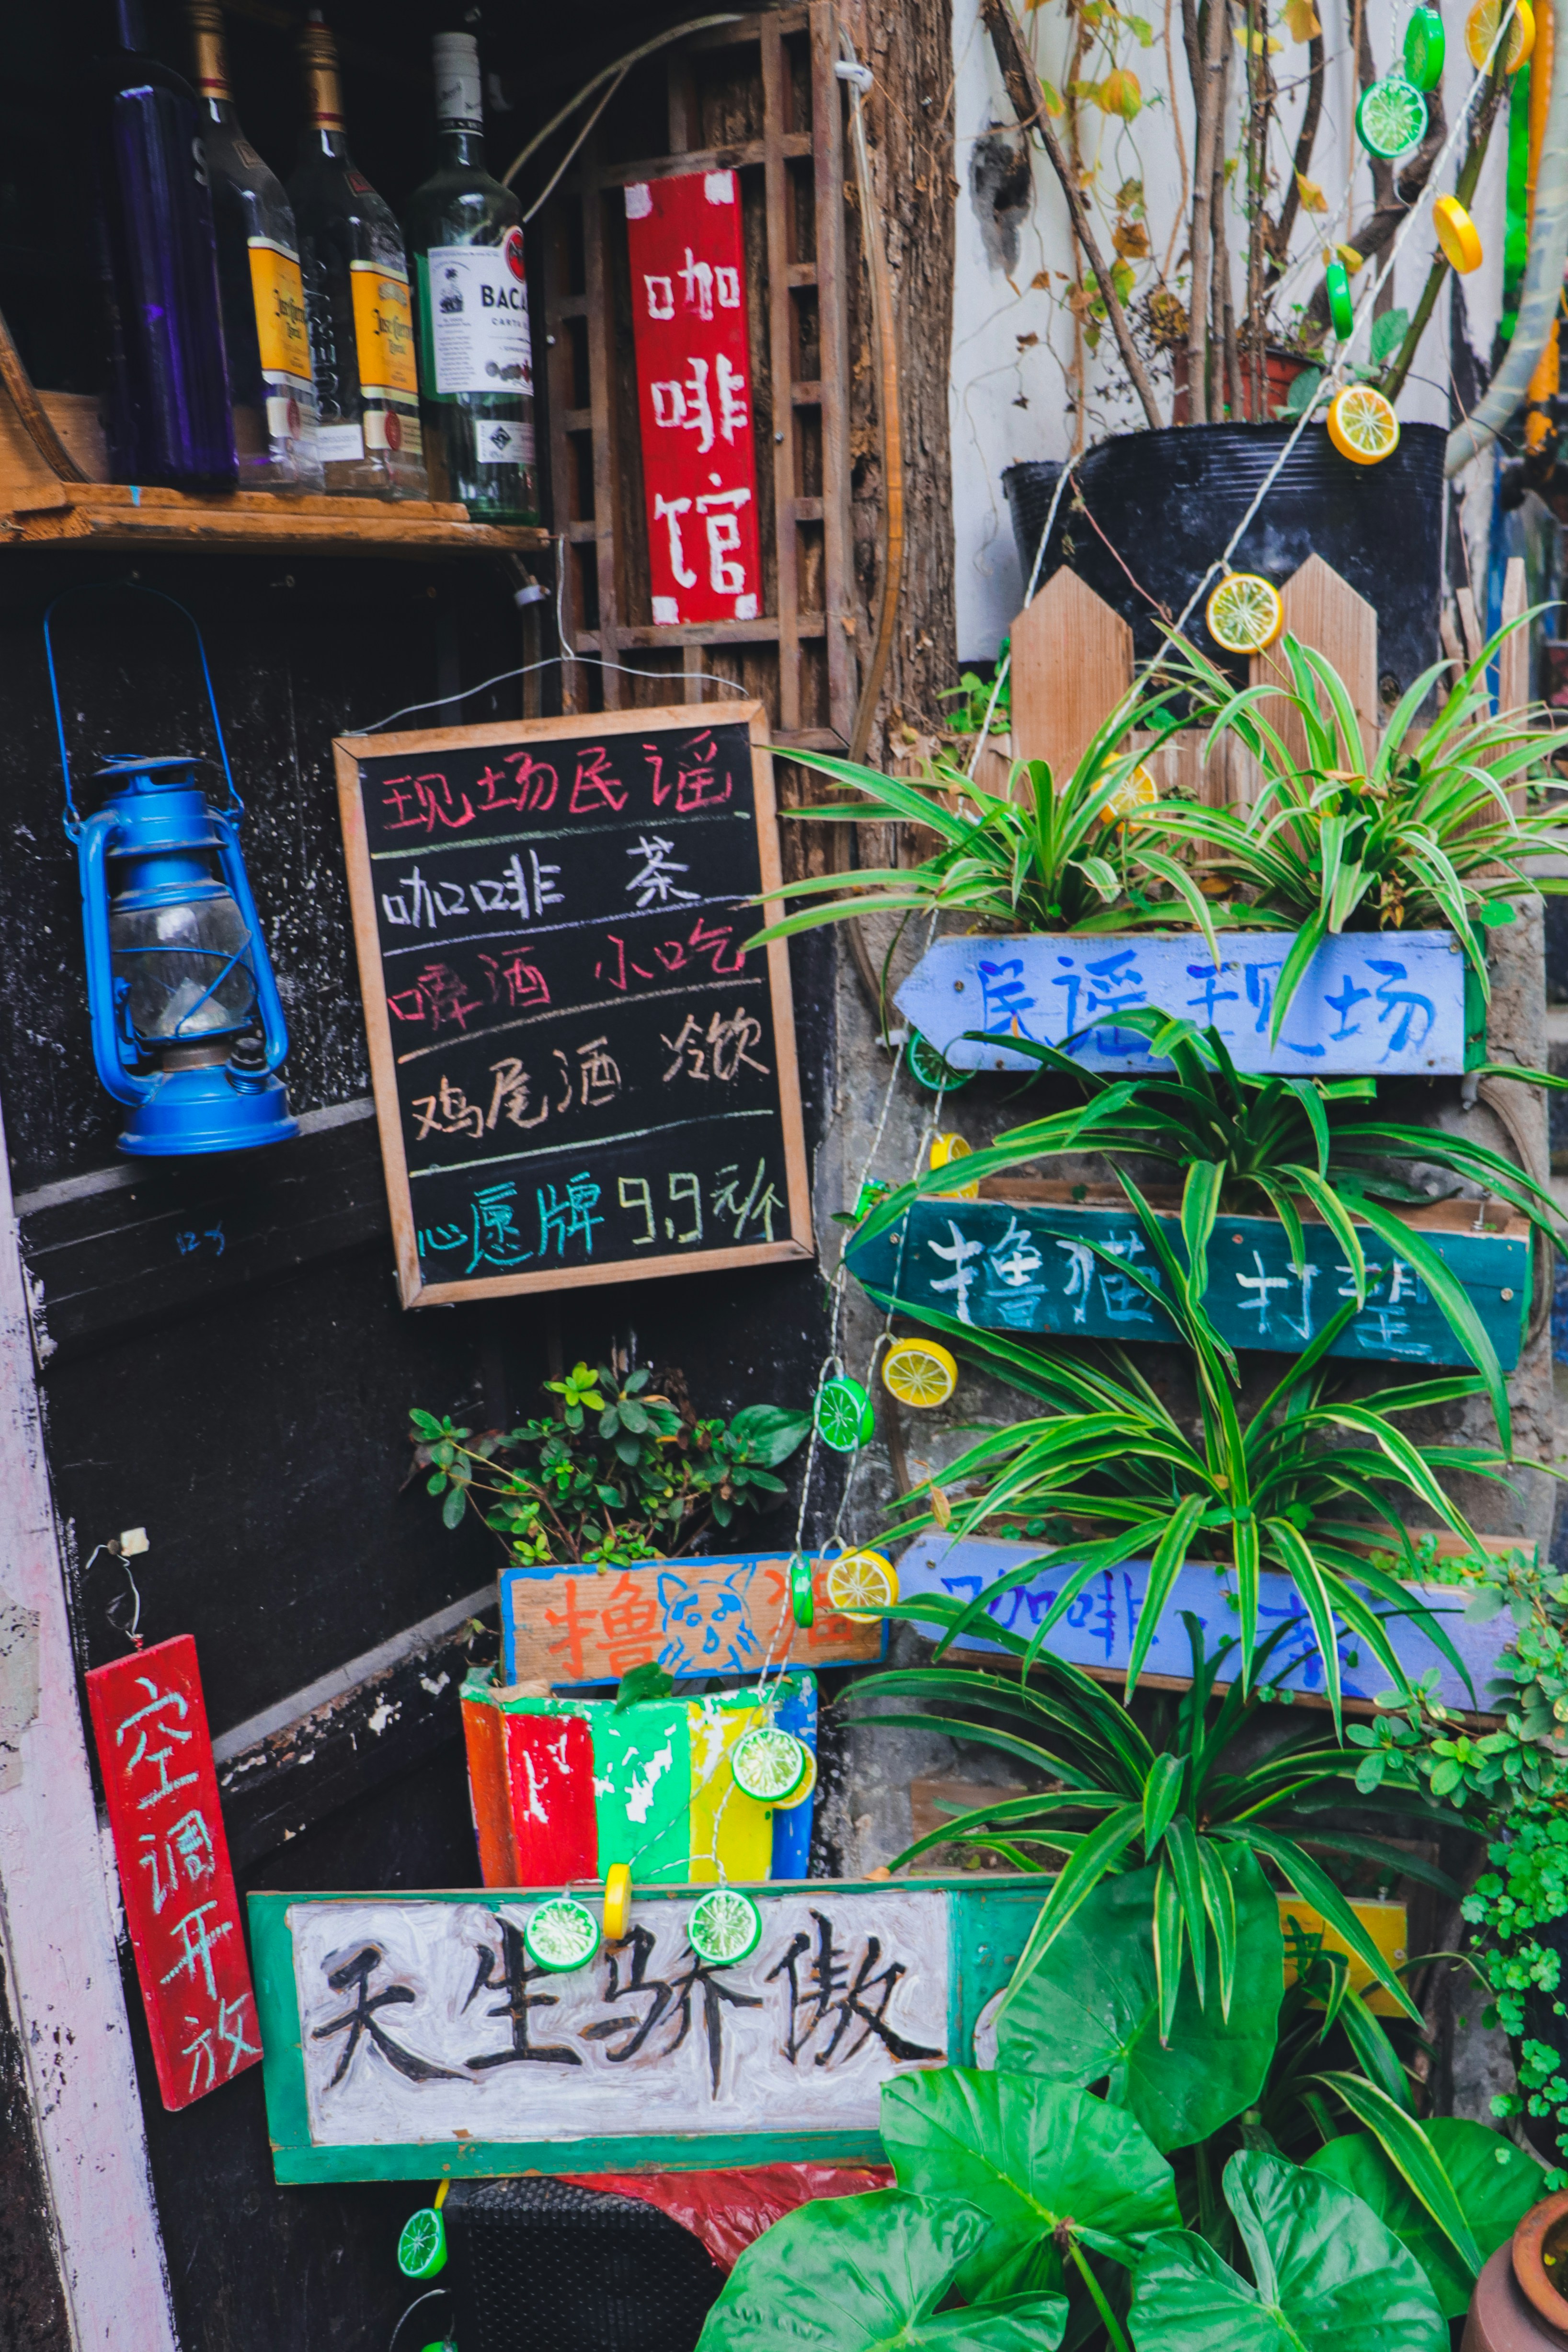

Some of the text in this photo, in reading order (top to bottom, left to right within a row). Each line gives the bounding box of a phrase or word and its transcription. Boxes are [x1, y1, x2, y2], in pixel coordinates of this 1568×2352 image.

[643, 245, 752, 595] 咖啡馆
[382, 730, 732, 833] 现场民谣
[382, 835, 701, 928] 咖啡 茶
[388, 918, 746, 1031] 啤酒 小吃
[976, 947, 1435, 1063] 民谣现场
[412, 1007, 769, 1141] 鸡尾酒 冷饮
[115, 1677, 263, 2094] 空调开放
[311, 1908, 949, 2102] 天生骄傲
